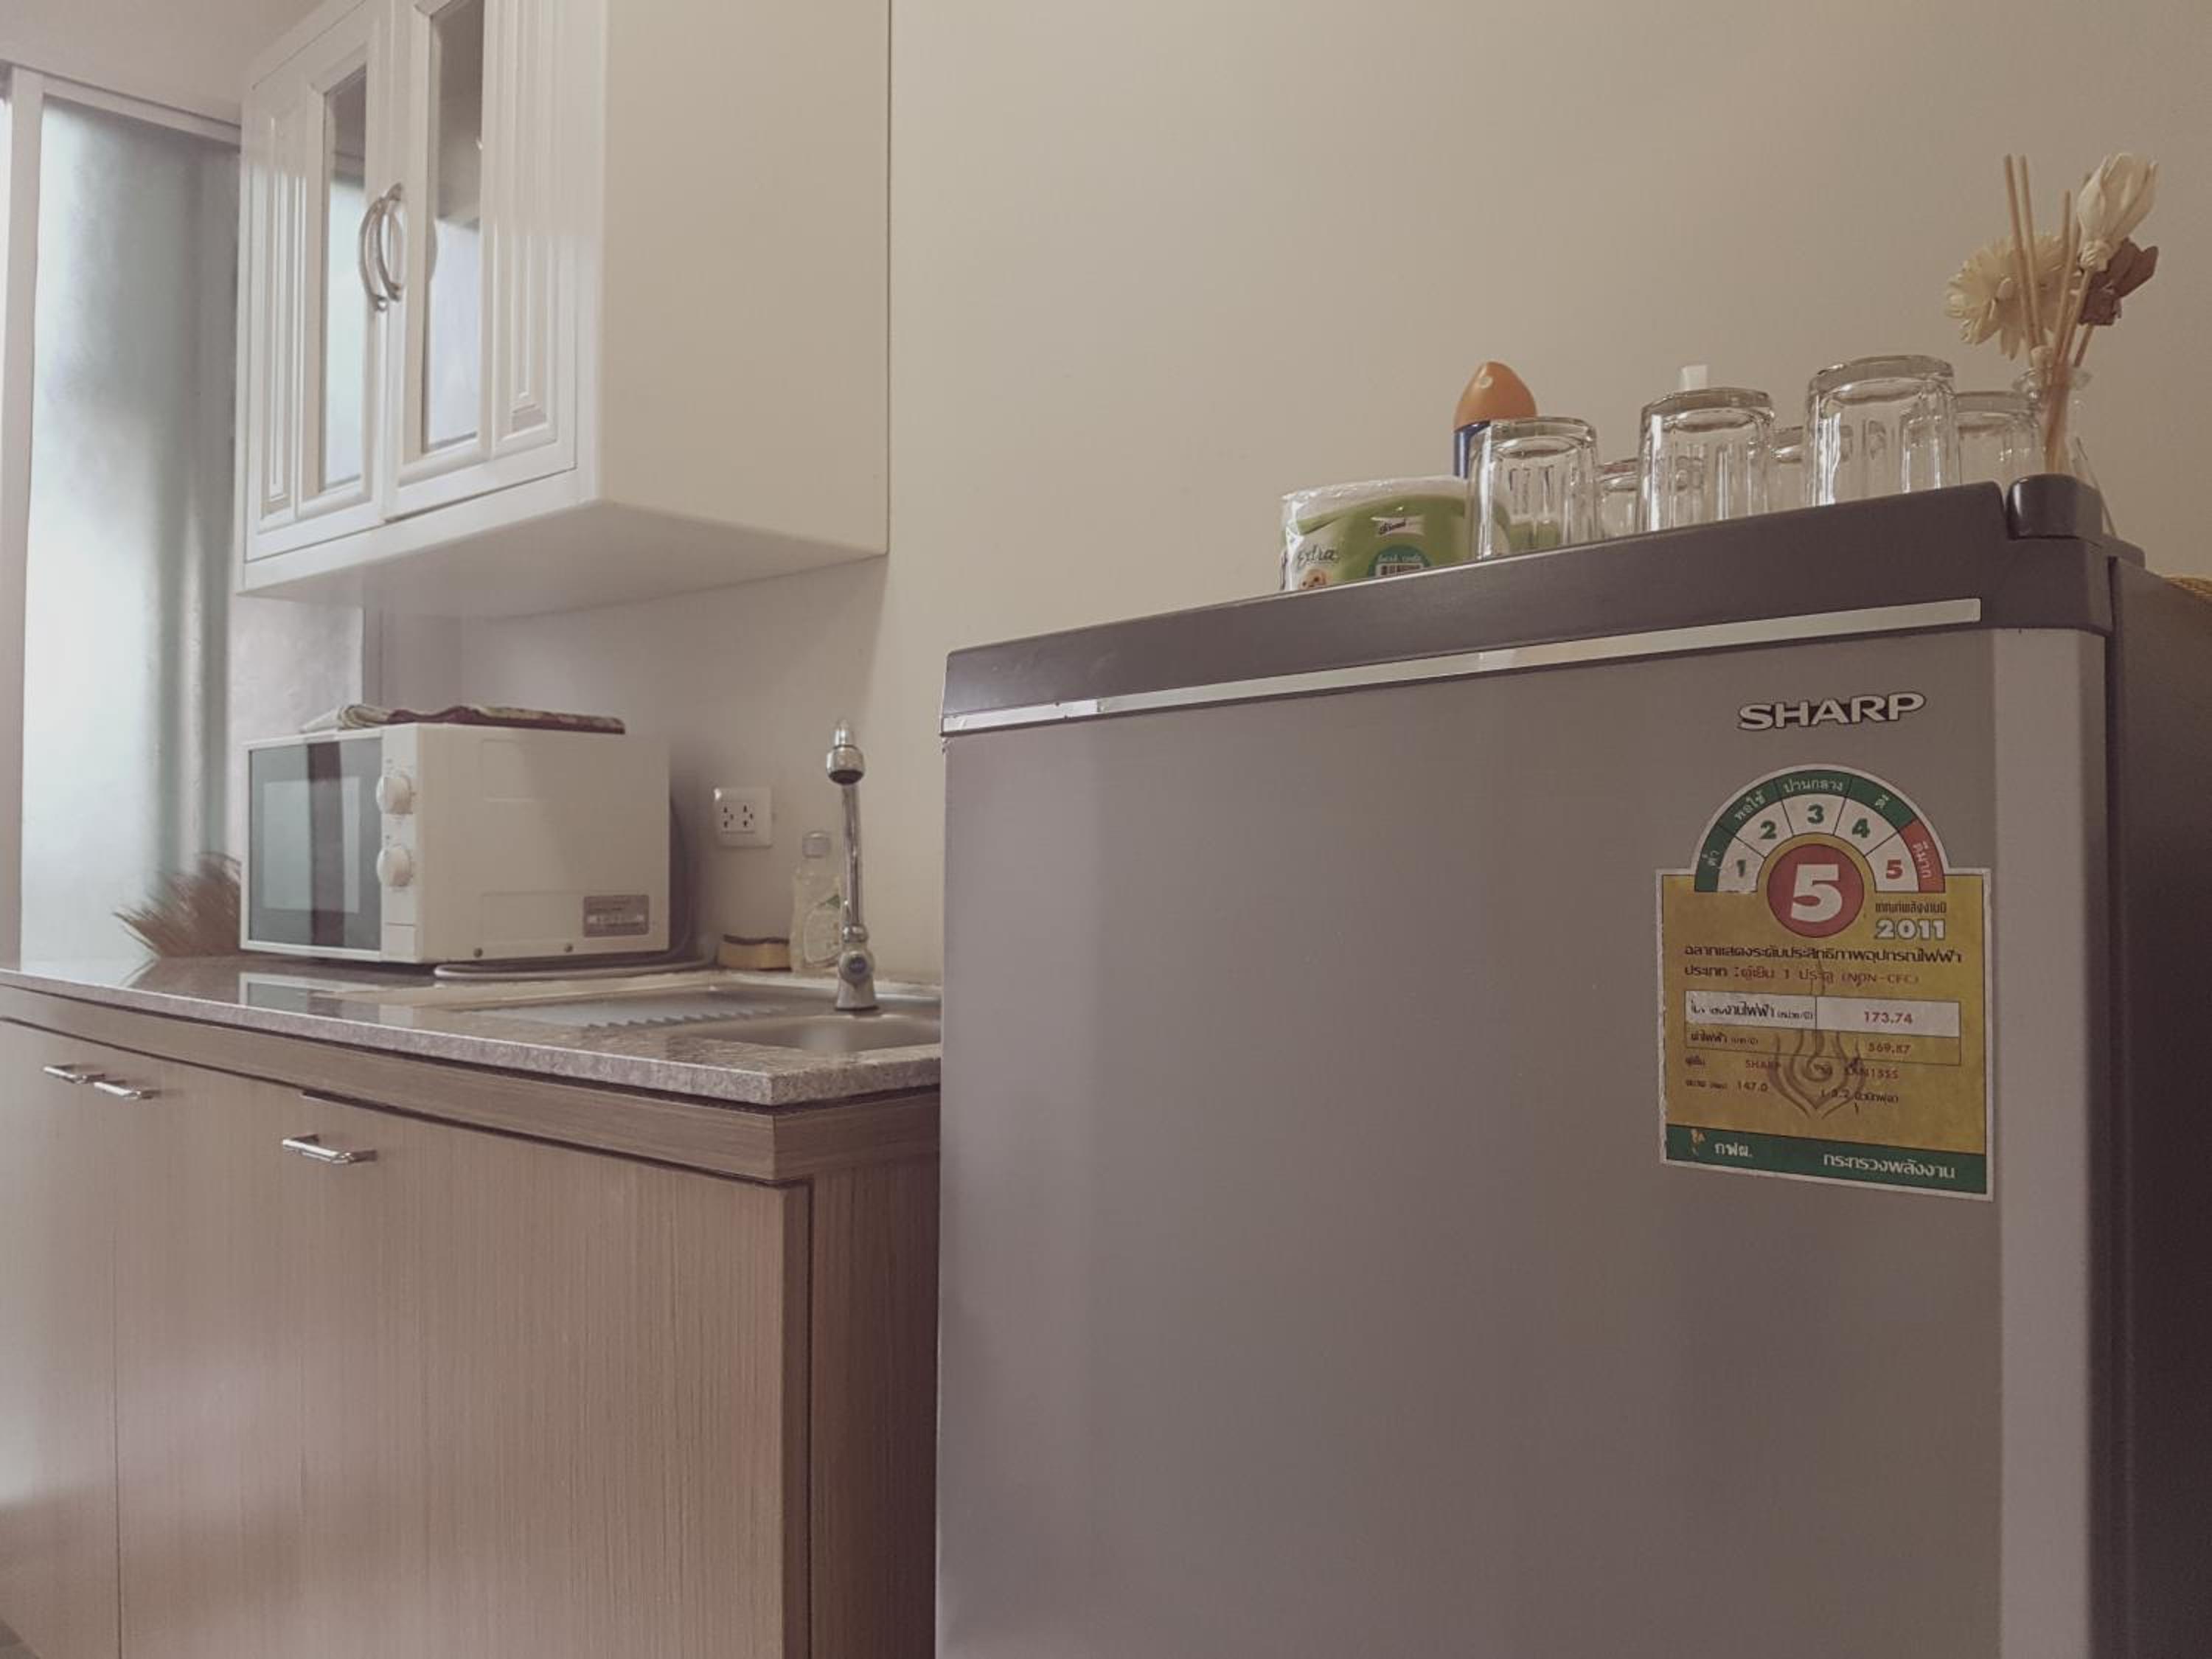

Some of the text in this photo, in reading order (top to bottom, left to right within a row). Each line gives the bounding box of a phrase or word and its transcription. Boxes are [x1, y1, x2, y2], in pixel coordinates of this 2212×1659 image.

[1737, 692, 1925, 730] SHARP
[1783, 779, 1843, 793] ปานกลาง
[1807, 804, 1825, 824] 3
[1759, 820, 1777, 840] 2
[1851, 818, 1870, 838] 4
[1736, 859, 1747, 877] 1
[1885, 860, 1903, 879] 5
[1791, 863, 1843, 922] 5
[1874, 918, 1946, 941] 2011
[1864, 1011, 1913, 1024] 173.74
[1714, 1141, 1753, 1158] กฟผ.
[1823, 1152, 1955, 1180] กระทรวงพลังงาน
